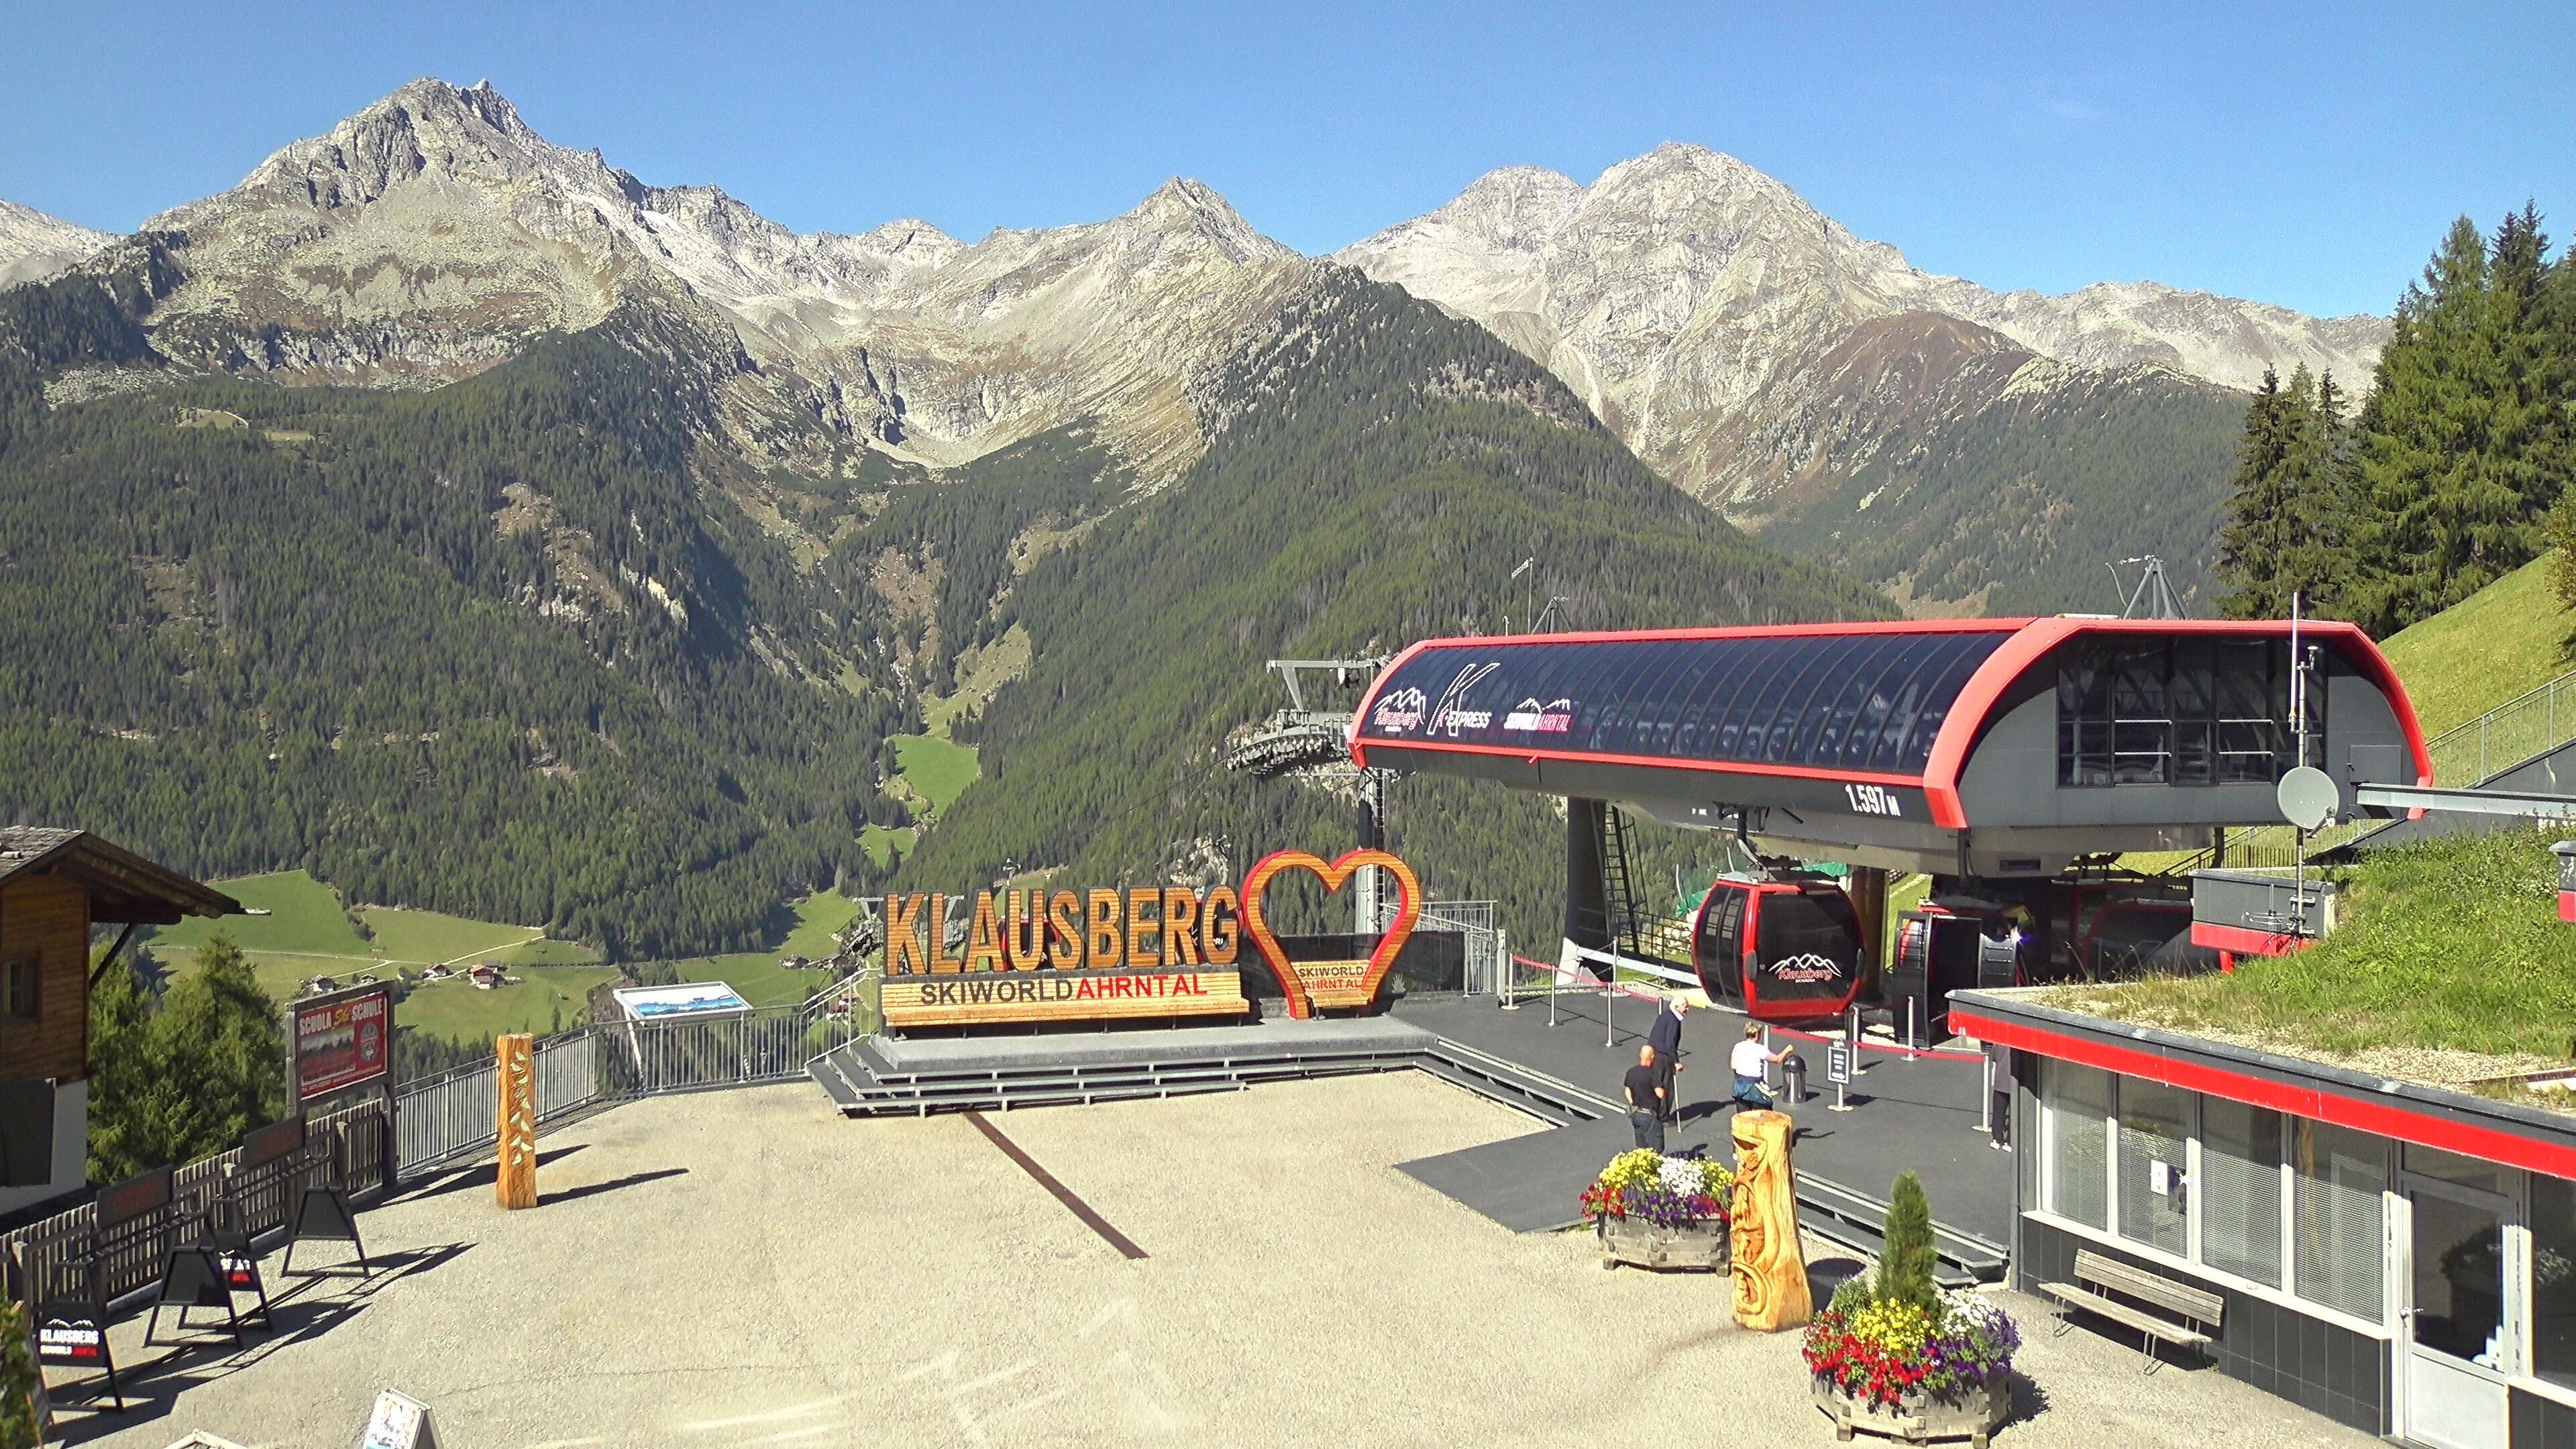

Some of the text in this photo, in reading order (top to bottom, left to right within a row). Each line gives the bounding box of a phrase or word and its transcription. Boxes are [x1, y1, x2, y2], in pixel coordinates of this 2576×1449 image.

[885, 885, 1238, 976] KLAUSBERG
[1299, 967, 1364, 977] SKIWORLD
[1304, 979, 1362, 989] AHRNTAL
[299, 1012, 332, 1036] SCUOLA
[351, 998, 382, 1022] SCHULE
[41, 1329, 99, 1345] KLAUSBERG
